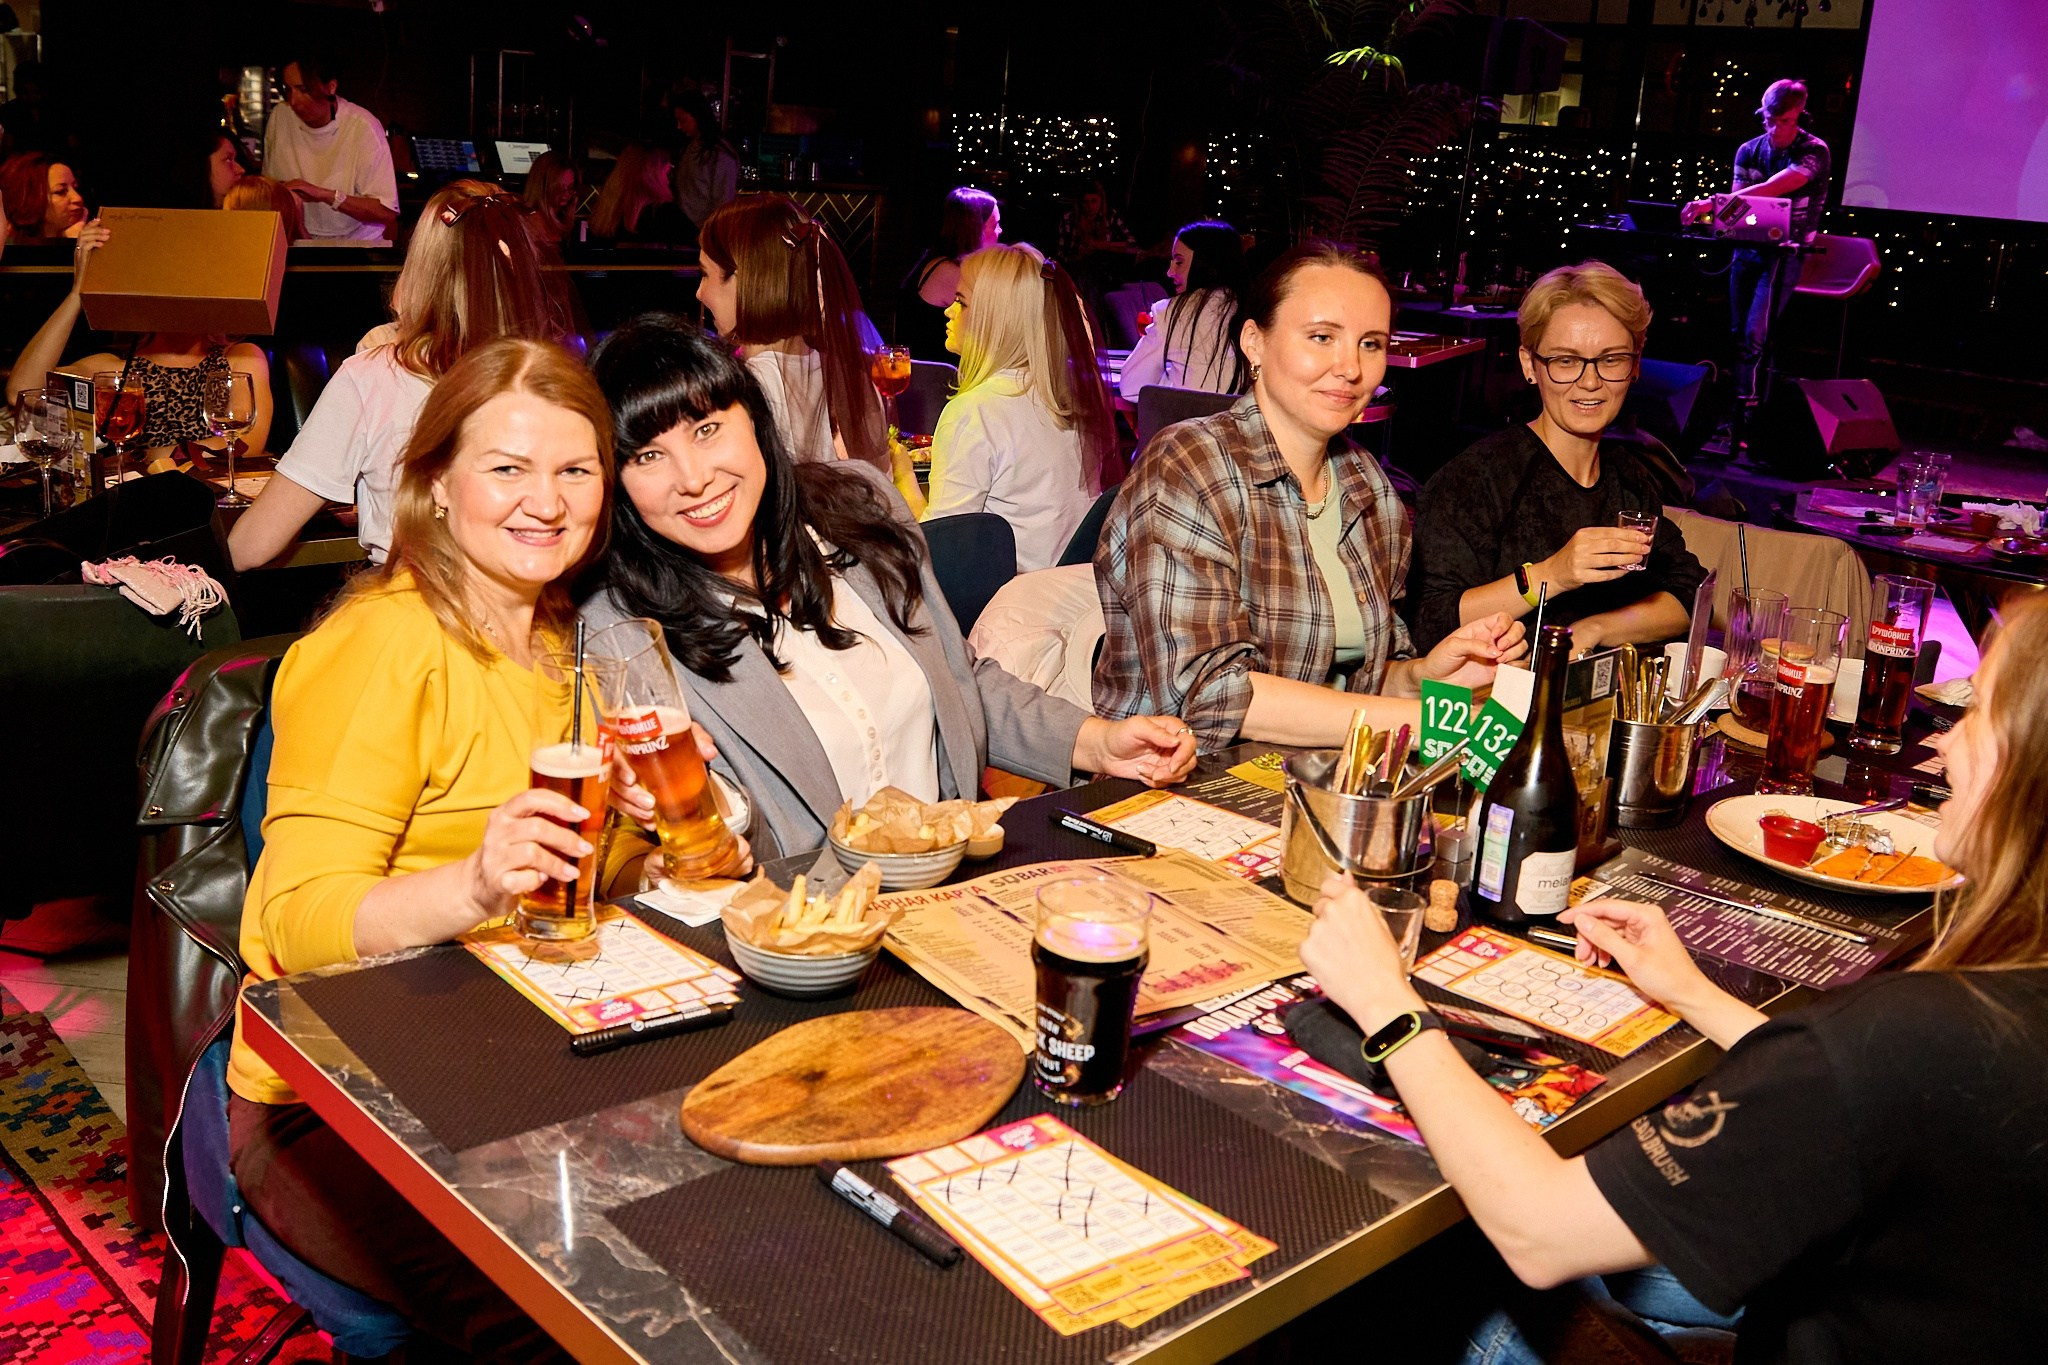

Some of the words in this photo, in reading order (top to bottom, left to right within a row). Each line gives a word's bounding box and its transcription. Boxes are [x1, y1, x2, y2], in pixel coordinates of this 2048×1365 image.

[1425, 695, 1469, 735] 122
[1474, 715, 1519, 762] 132
[867, 895, 930, 911] АРНАЯ
[1048, 1037, 1096, 1062] SHEEP
